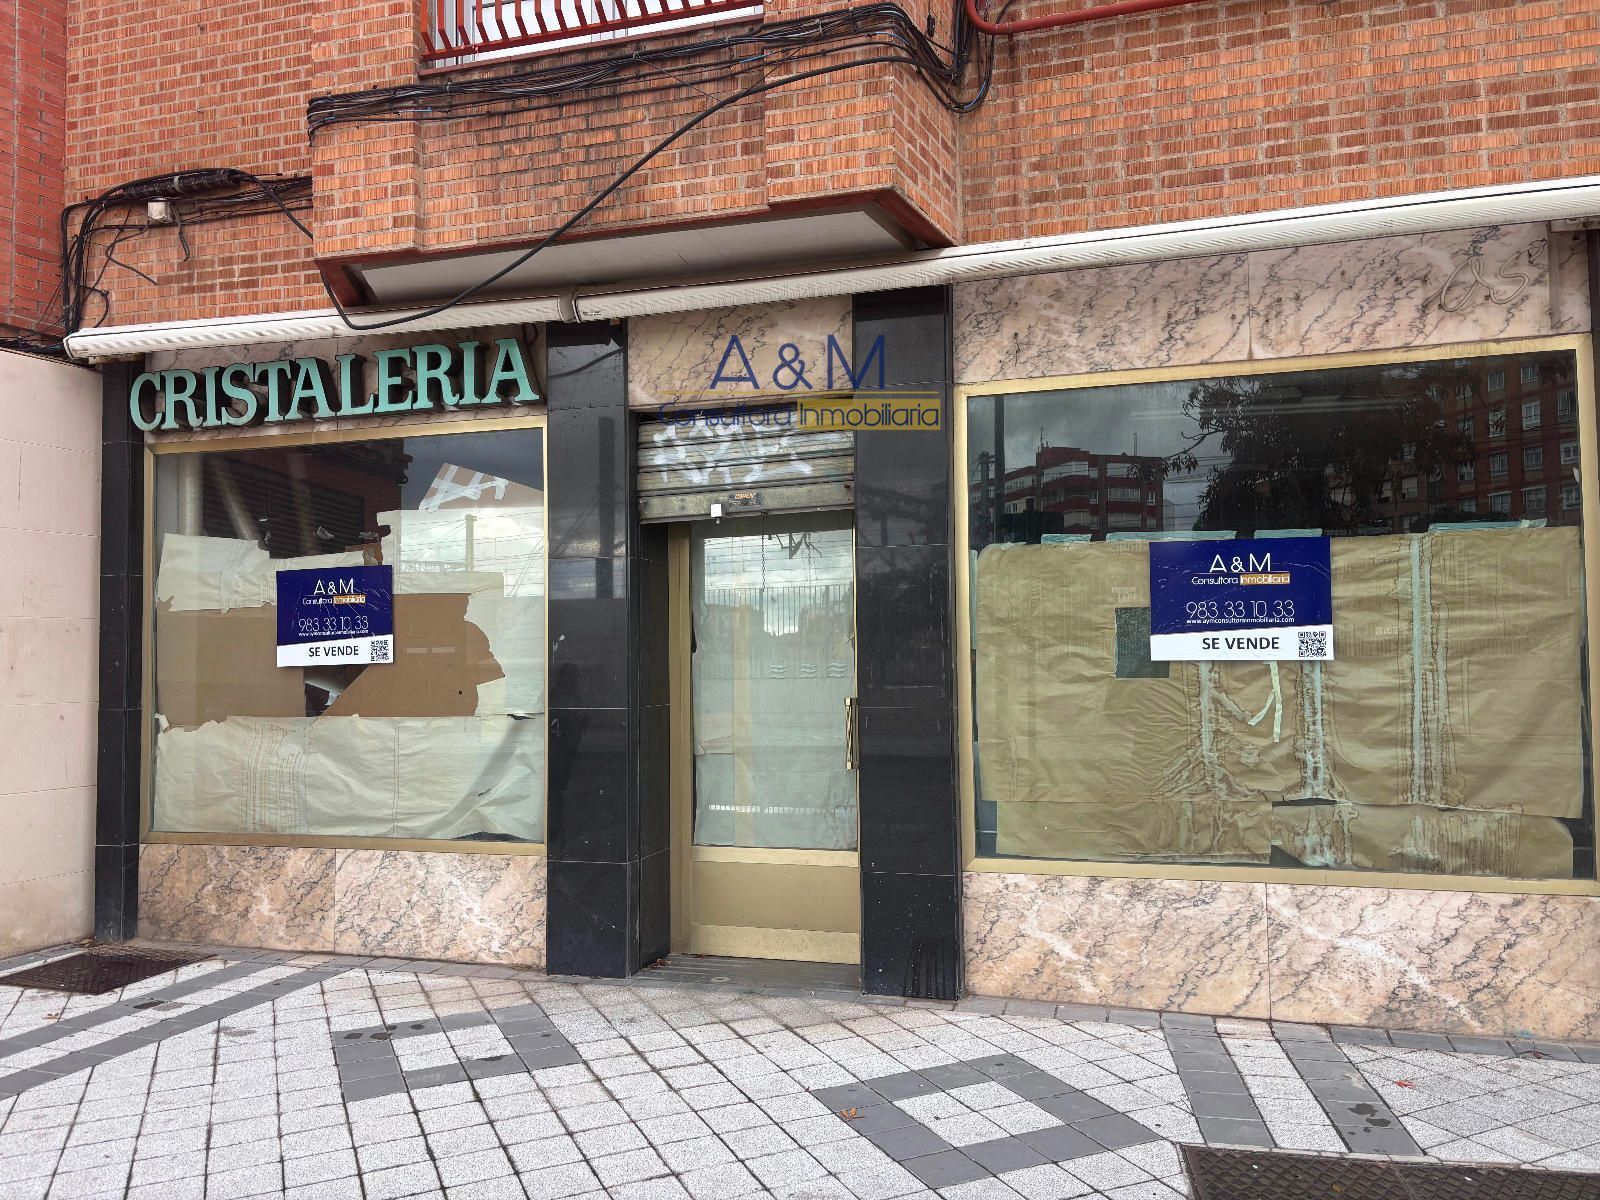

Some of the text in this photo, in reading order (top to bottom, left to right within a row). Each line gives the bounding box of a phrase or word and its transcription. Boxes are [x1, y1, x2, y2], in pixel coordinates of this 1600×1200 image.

[130, 337, 541, 432] CRISTALERIA
[1192, 573, 1290, 585] Consultora Inmobiliaria
[1186, 599, 1295, 618] 983 33 10 33
[298, 615, 369, 632] 983 33 10 33
[1202, 636, 1280, 650] SE VENDE
[308, 645, 359, 657] SE VENDE
